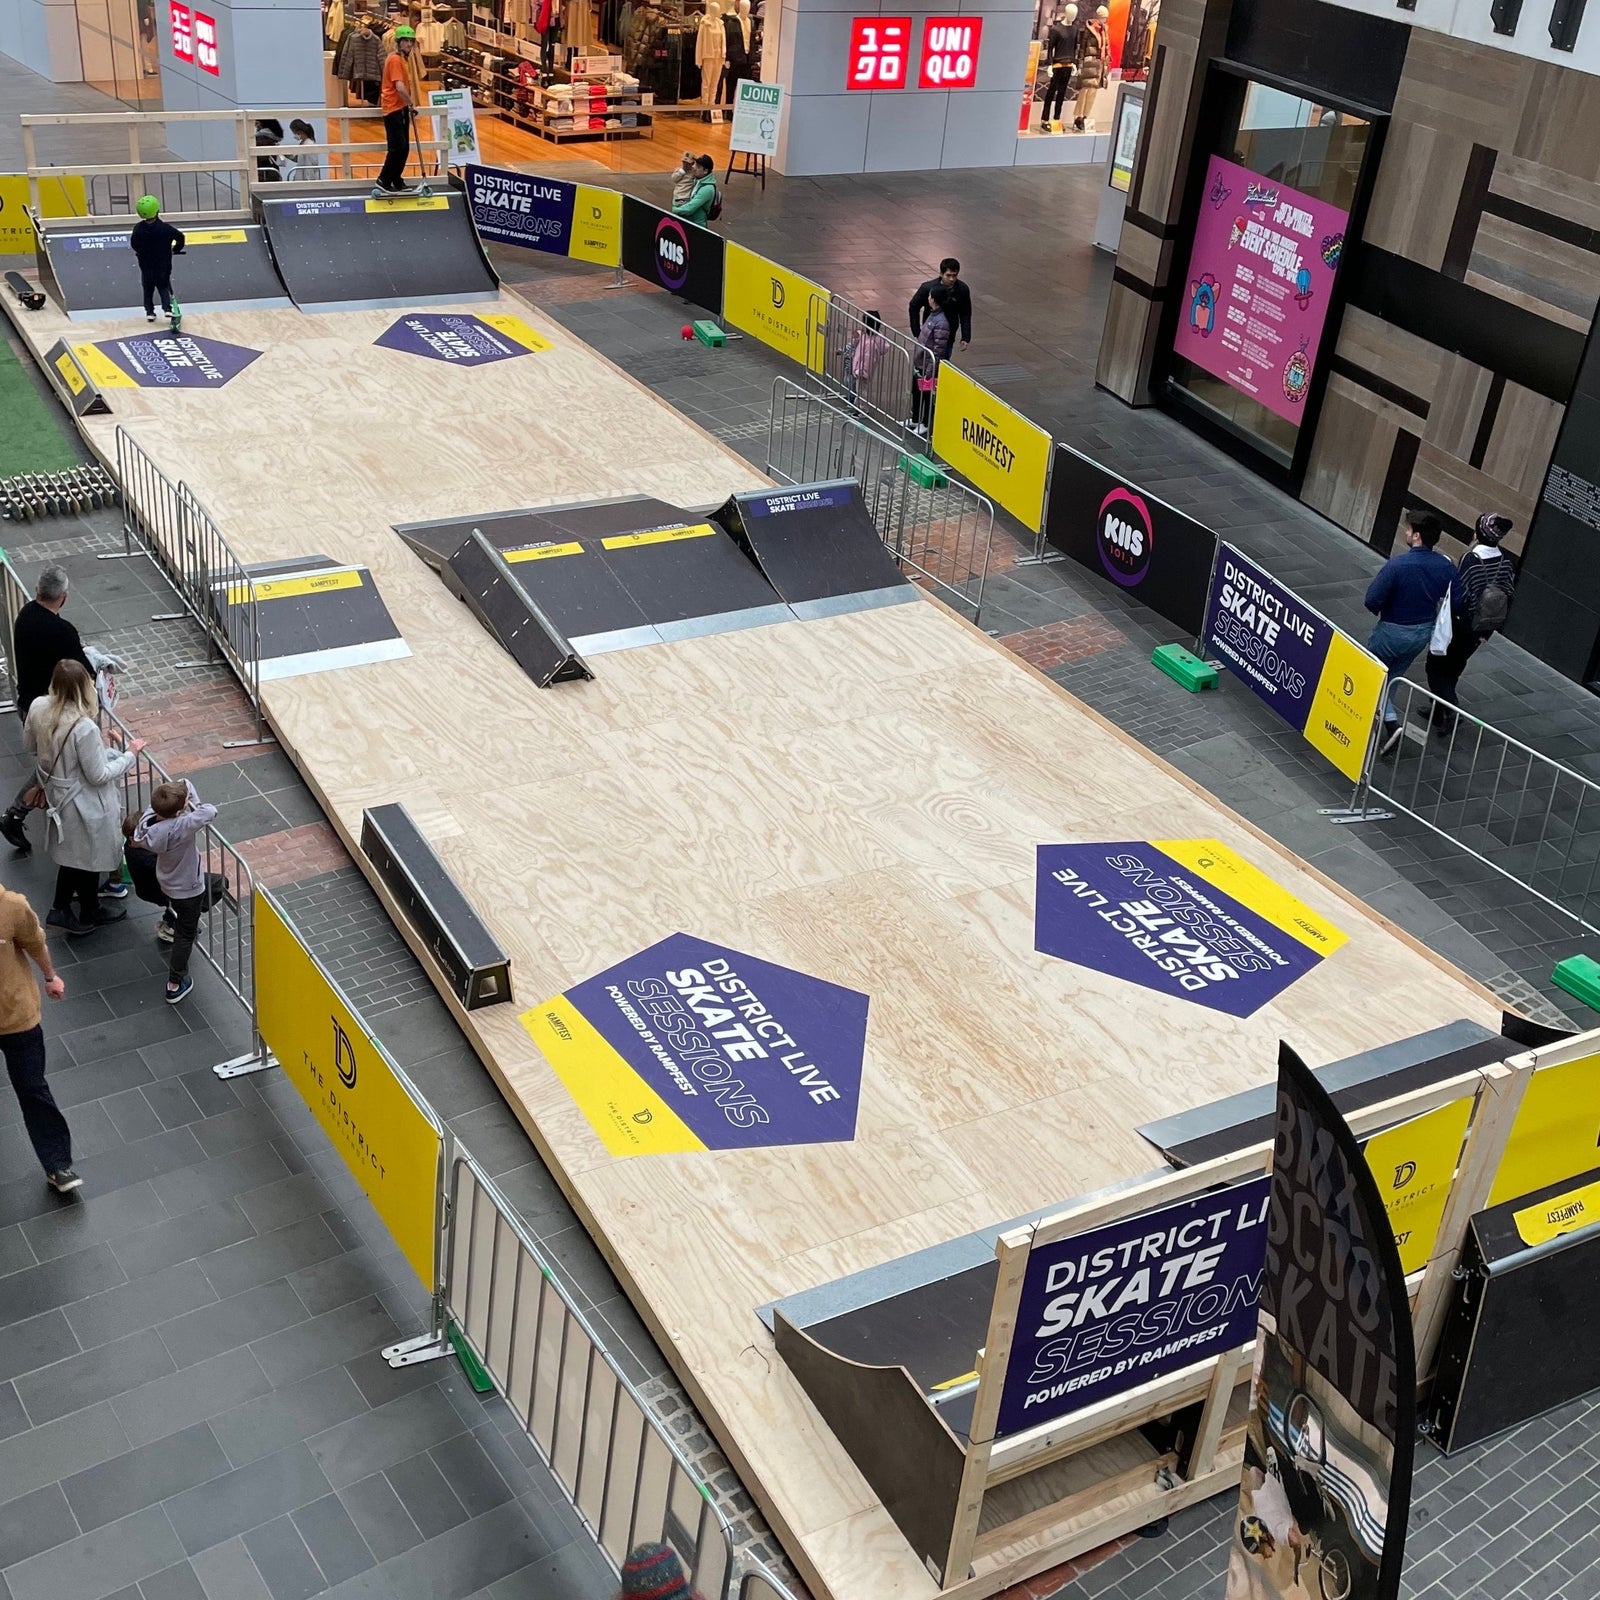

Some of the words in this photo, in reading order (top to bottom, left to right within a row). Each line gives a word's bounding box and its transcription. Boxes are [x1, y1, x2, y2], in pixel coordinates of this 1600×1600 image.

[929, 27, 971, 51] UNI
[926, 54, 972, 84] QLO
[743, 87, 778, 103] JOIN:
[474, 173, 531, 195] DISTRICT
[533, 185, 562, 201] LIVE
[474, 188, 532, 213] SKATE
[474, 205, 563, 237] SESSIONS
[475, 223, 501, 235] POWERED
[510, 231, 540, 242] RAMPFEST
[659, 237, 684, 265] KIIS
[1240, 228, 1264, 255] EVENT
[1263, 239, 1303, 275] SCHEDULE
[405, 320, 425, 337] LIVE
[434, 331, 480, 358] SKATE
[752, 308, 765, 321] THE
[768, 314, 800, 340] DISTRICT
[129, 341, 180, 383] SESSIONS
[153, 339, 193, 367] SKATE
[176, 337, 209, 367] DISTRICT
[199, 363, 223, 380] LIVE
[422, 334, 460, 359] DISTRICT
[962, 417, 1015, 473] RAMPFEST
[766, 494, 801, 506] DISTRICT
[802, 492, 820, 501] LIVE
[769, 503, 795, 513] SKATE
[1104, 513, 1144, 556] KIIS
[1110, 545, 1134, 566] 101.1
[1219, 584, 1281, 647] SKATE
[1224, 560, 1283, 619] DISTRICT
[1283, 608, 1315, 646] LIVE
[1211, 633, 1240, 663] POWERED
[1238, 656, 1248, 669] BY
[1246, 664, 1278, 695] RAMPFEST
[1214, 609, 1306, 699] SESSIONS
[1324, 719, 1351, 748] RAMPFEST
[1052, 868, 1109, 908] LIVE
[1168, 876, 1221, 916] RAMPFEST
[1105, 854, 1272, 973] SESSIONS
[1219, 912, 1238, 927] BY
[1294, 917, 1328, 943] RAMPFEST
[1097, 907, 1208, 992] DISTRICT
[1119, 899, 1241, 982] SKATE
[1234, 924, 1291, 966] POWERED
[545, 1012, 572, 1041] RAMPFEST
[665, 968, 770, 1063] SKATE
[701, 958, 797, 1049] DISTRICT
[780, 1052, 841, 1105] LIVE
[604, 985, 647, 1033] POWERED
[639, 1030, 658, 1043] BY
[649, 1041, 698, 1096] RAMPFEST
[626, 978, 770, 1129] SESSIONS
[303, 1051, 324, 1088] THE
[330, 1090, 386, 1180] DISTRICT
[1547, 1200, 1585, 1224] RAMPFEST
[1045, 1209, 1231, 1293] DISTRICT
[1236, 1195, 1271, 1231] LI
[1266, 1166, 1381, 1332] SCOO
[1035, 1242, 1227, 1337] SKATE
[1027, 1268, 1265, 1383] SESSION
[1023, 1366, 1111, 1409] POWERED
[1113, 1355, 1140, 1376] BY
[1139, 1322, 1229, 1365] RAMPFEST
